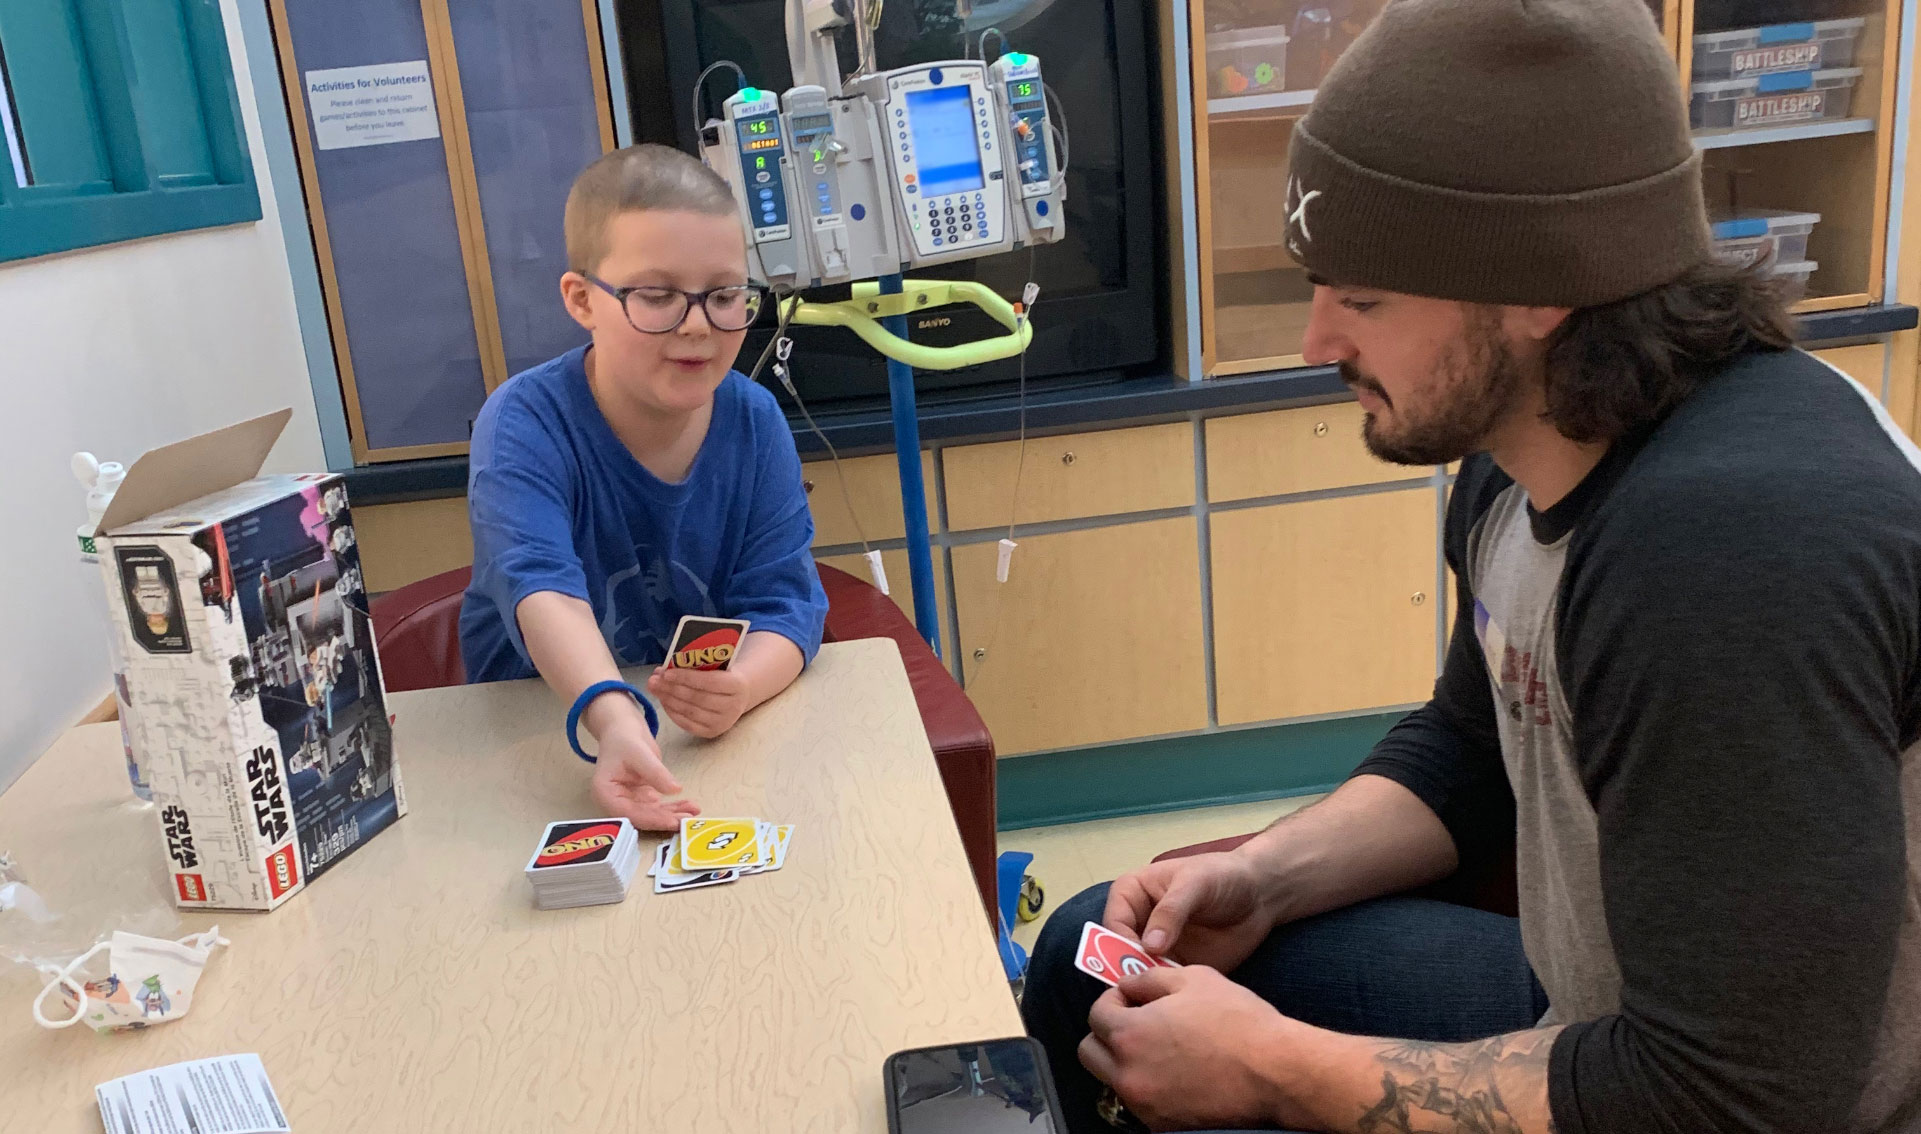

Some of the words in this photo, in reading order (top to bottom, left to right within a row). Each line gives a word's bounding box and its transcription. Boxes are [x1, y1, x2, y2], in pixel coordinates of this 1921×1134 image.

[1735, 45, 1818, 71] BATTLESHIP
[311, 81, 355, 93] Activities
[357, 78, 371, 89] for
[373, 74, 426, 88] Volunteers
[330, 98, 353, 108] Please
[375, 95, 389, 103] and
[387, 106, 401, 114] this
[1739, 94, 1820, 119] BATTLESHIP
[345, 122, 370, 132] before
[371, 121, 384, 131] you
[750, 120, 767, 134] 45
[756, 156, 766, 169] A
[918, 317, 951, 329] SANYO
[673, 643, 735, 669] UNO
[246, 748, 277, 846] STAR
[258, 745, 289, 842] WARS
[162, 805, 187, 869] STAR
[173, 805, 199, 869] WARS
[543, 834, 616, 858] UNO
[273, 851, 291, 890] LEGO
[183, 875, 200, 900] LEGO
